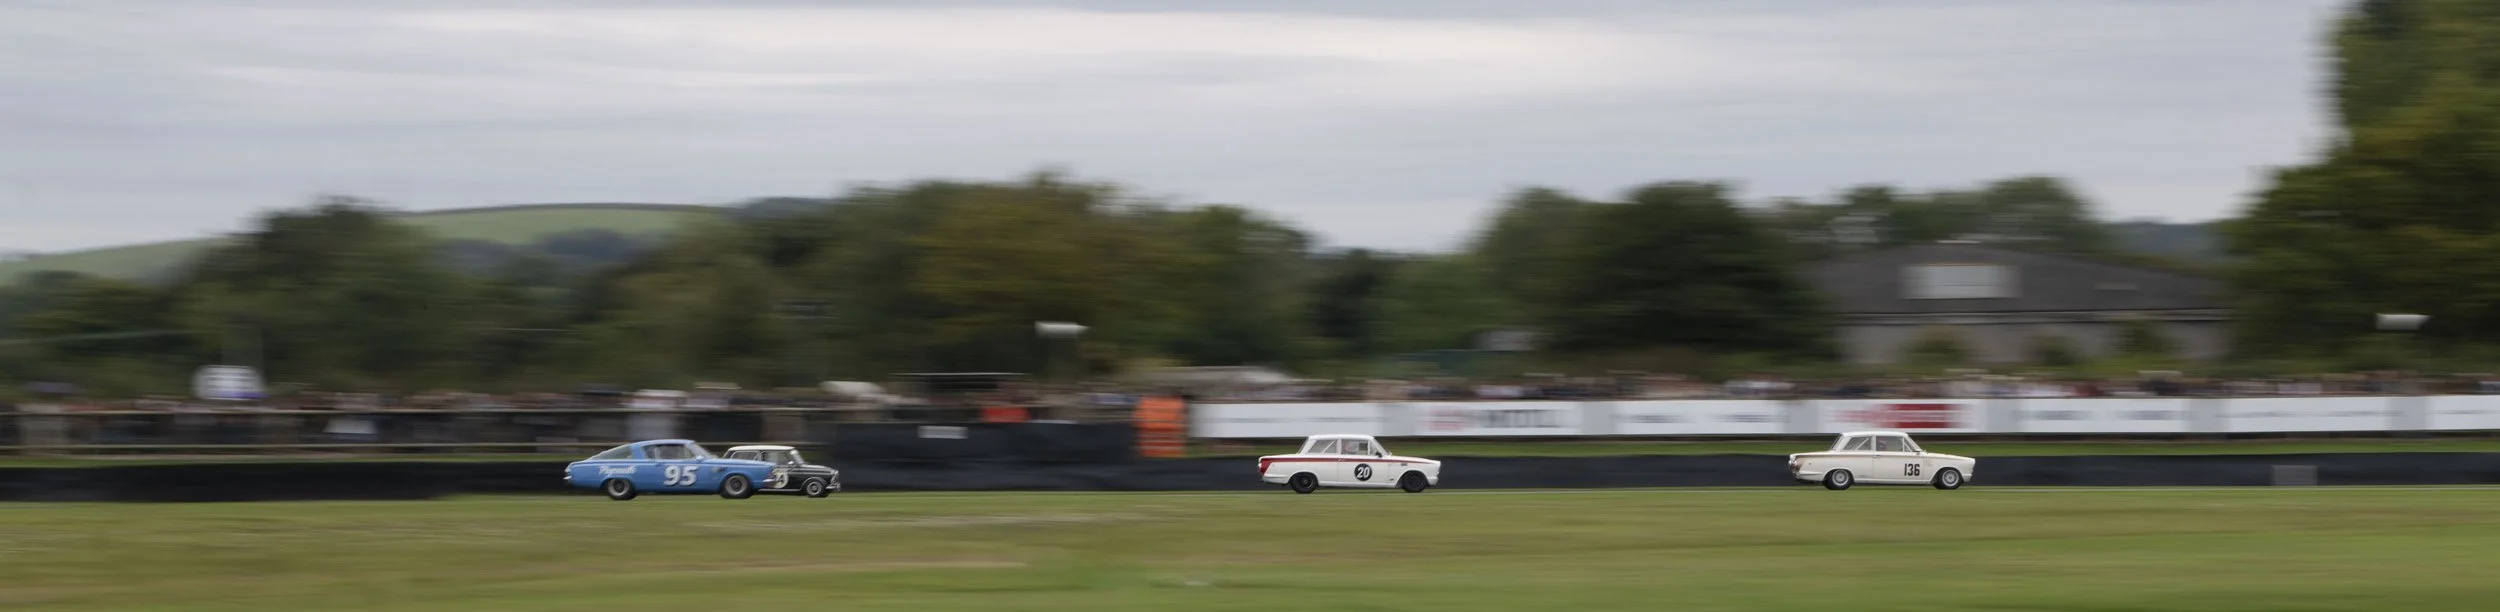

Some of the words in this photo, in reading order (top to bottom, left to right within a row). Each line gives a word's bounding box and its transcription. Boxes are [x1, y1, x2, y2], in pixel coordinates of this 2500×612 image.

[663, 464, 700, 487] 95
[1356, 466, 1371, 479] 20
[1904, 463, 1920, 476] 136
